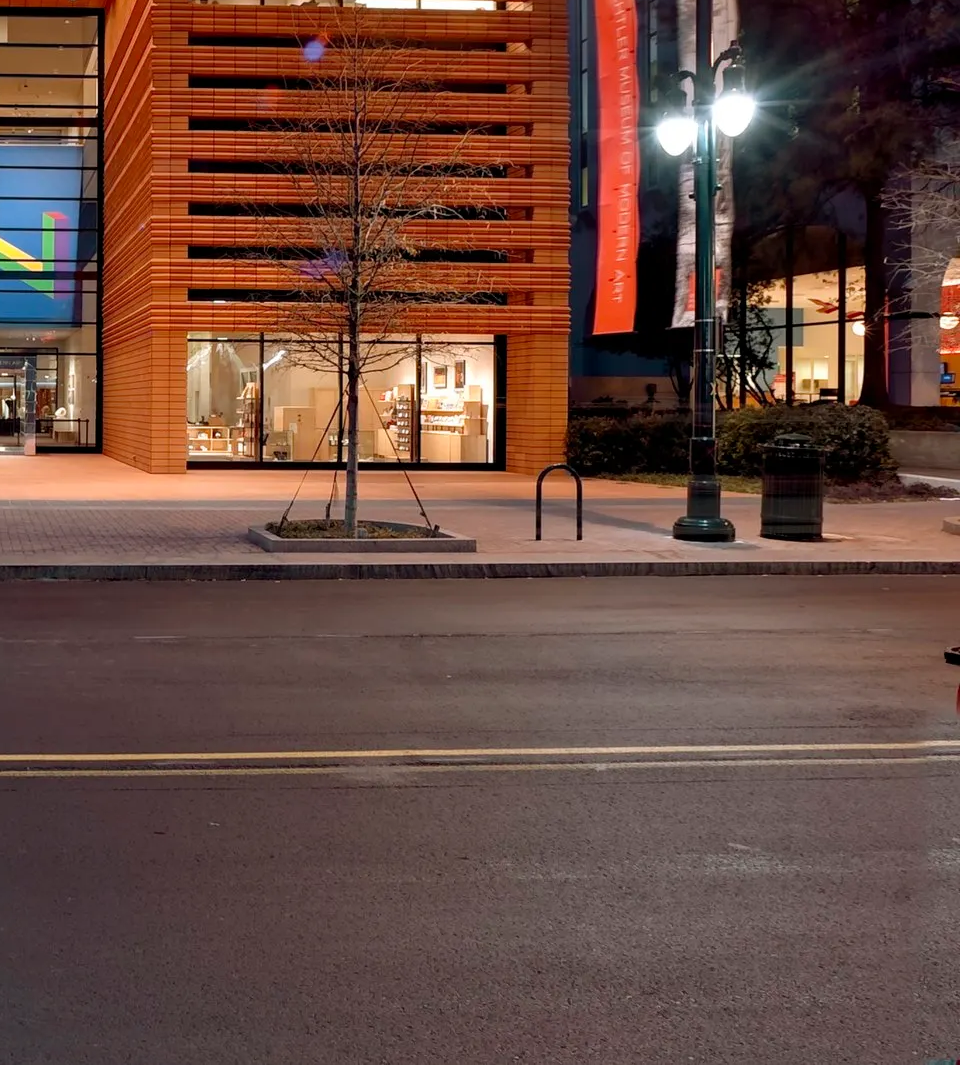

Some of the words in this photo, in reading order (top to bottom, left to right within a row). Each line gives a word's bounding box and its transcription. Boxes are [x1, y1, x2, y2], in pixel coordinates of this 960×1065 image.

[618, 66, 634, 145] MUSEUM
[619, 151, 633, 175] OF
[616, 183, 632, 262] MODERN
[611, 269, 626, 304] ART
